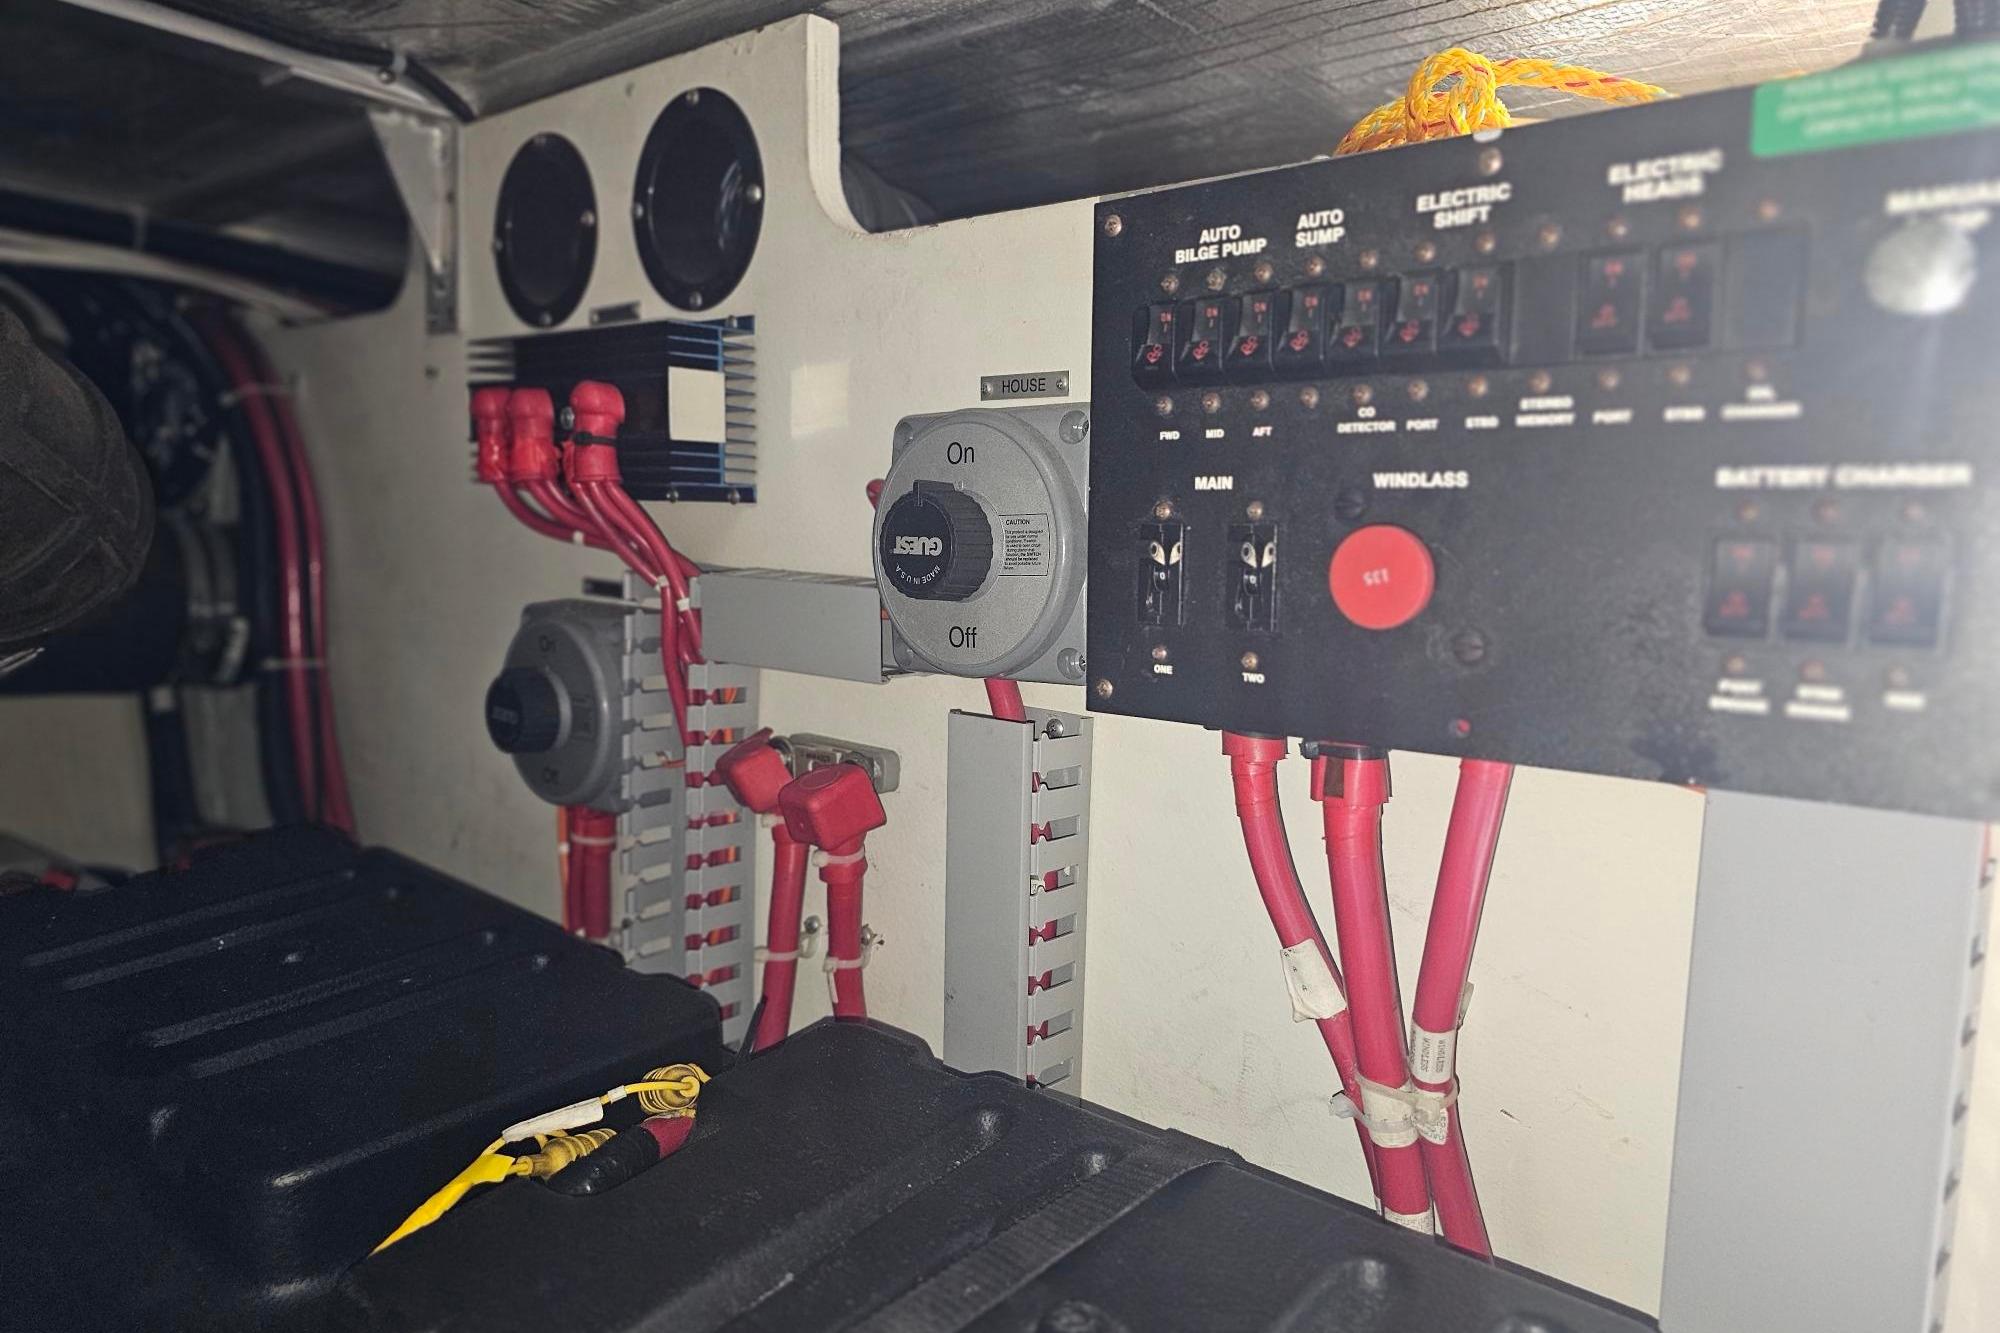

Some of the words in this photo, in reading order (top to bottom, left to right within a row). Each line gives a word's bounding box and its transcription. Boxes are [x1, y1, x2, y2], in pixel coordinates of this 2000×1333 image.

[1416, 182, 1512, 213] ELECTRIC
[1297, 209, 1344, 230] AUTO
[1434, 205, 1492, 229] SHIFT
[1200, 225, 1241, 244] AUTO
[1296, 227, 1345, 248] SUMP
[1175, 243, 1221, 264] BILGE
[1222, 238, 1267, 259] PUMP
[1002, 378, 1046, 394] HOUSE
[1358, 406, 1376, 418] CO
[1205, 429, 1224, 439] MID
[1252, 426, 1272, 438] AFT
[1337, 420, 1396, 433] DETECTOR
[1406, 418, 1439, 432] PORT
[1159, 430, 1180, 441] FWD
[947, 442, 975, 465] On
[1195, 476, 1233, 491] MAIN
[1373, 471, 1469, 489] WINDLASS
[893, 535, 943, 556] GUEST
[921, 565, 941, 584] MADE
[1363, 568, 1389, 587] 135
[949, 626, 977, 649] Off
[1154, 664, 1173, 675] ONE
[1241, 672, 1265, 684] TWO
